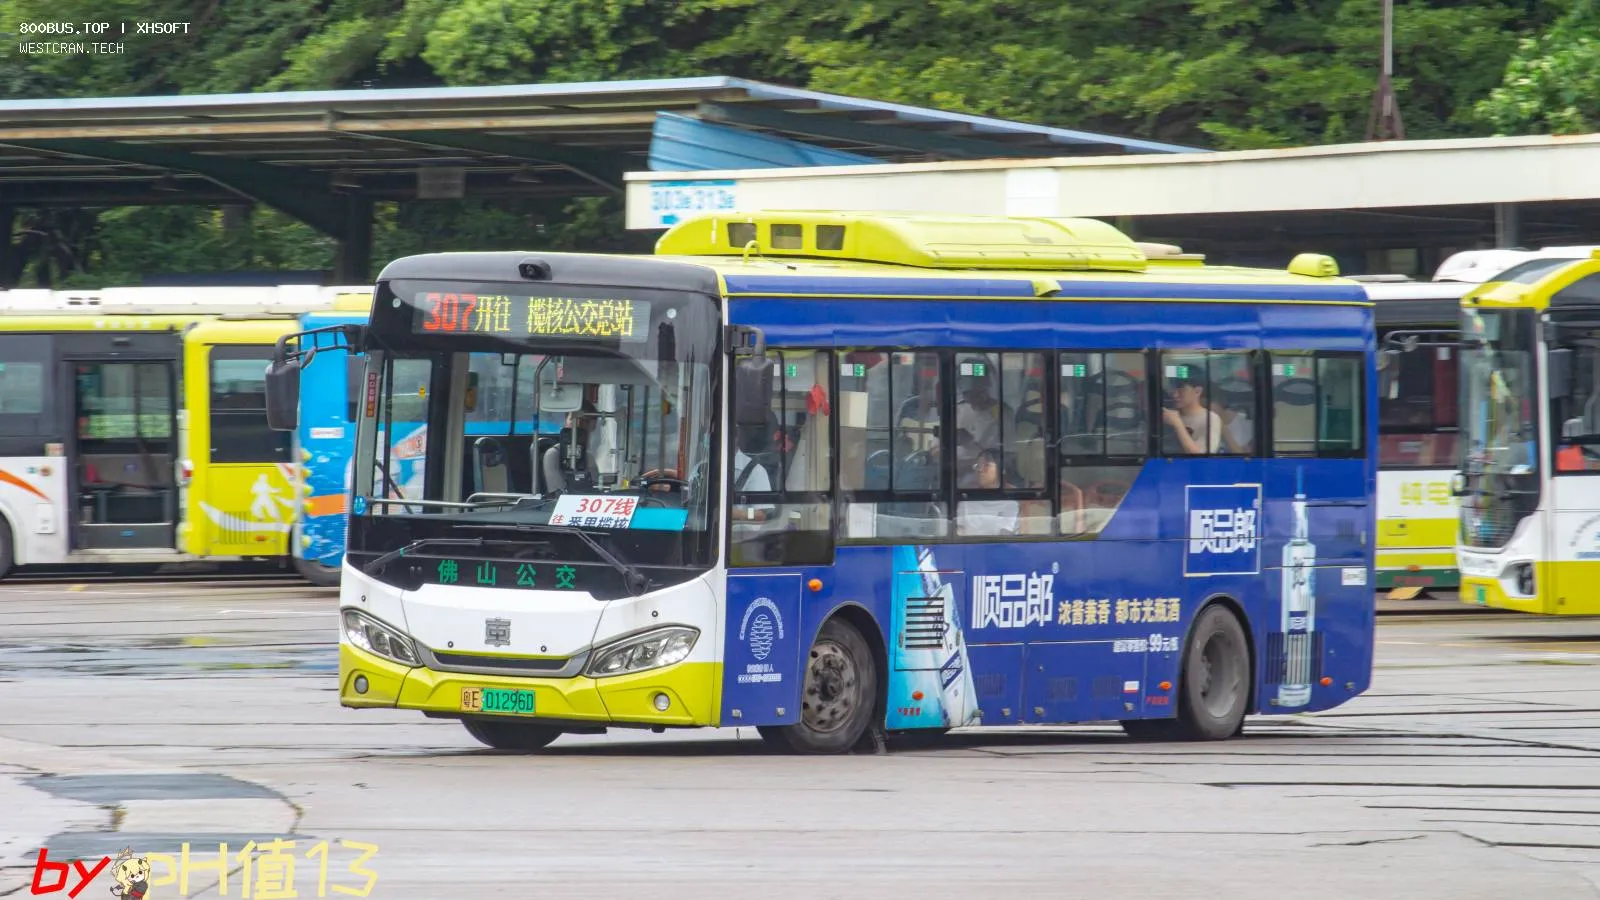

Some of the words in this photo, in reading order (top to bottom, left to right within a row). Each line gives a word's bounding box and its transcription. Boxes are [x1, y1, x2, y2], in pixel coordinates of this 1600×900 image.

[576, 498, 636, 516] 307线
[1189, 506, 1257, 554] 顺品郎
[437, 559, 577, 589] 佛山公交
[971, 570, 1054, 630] 顺品郎
